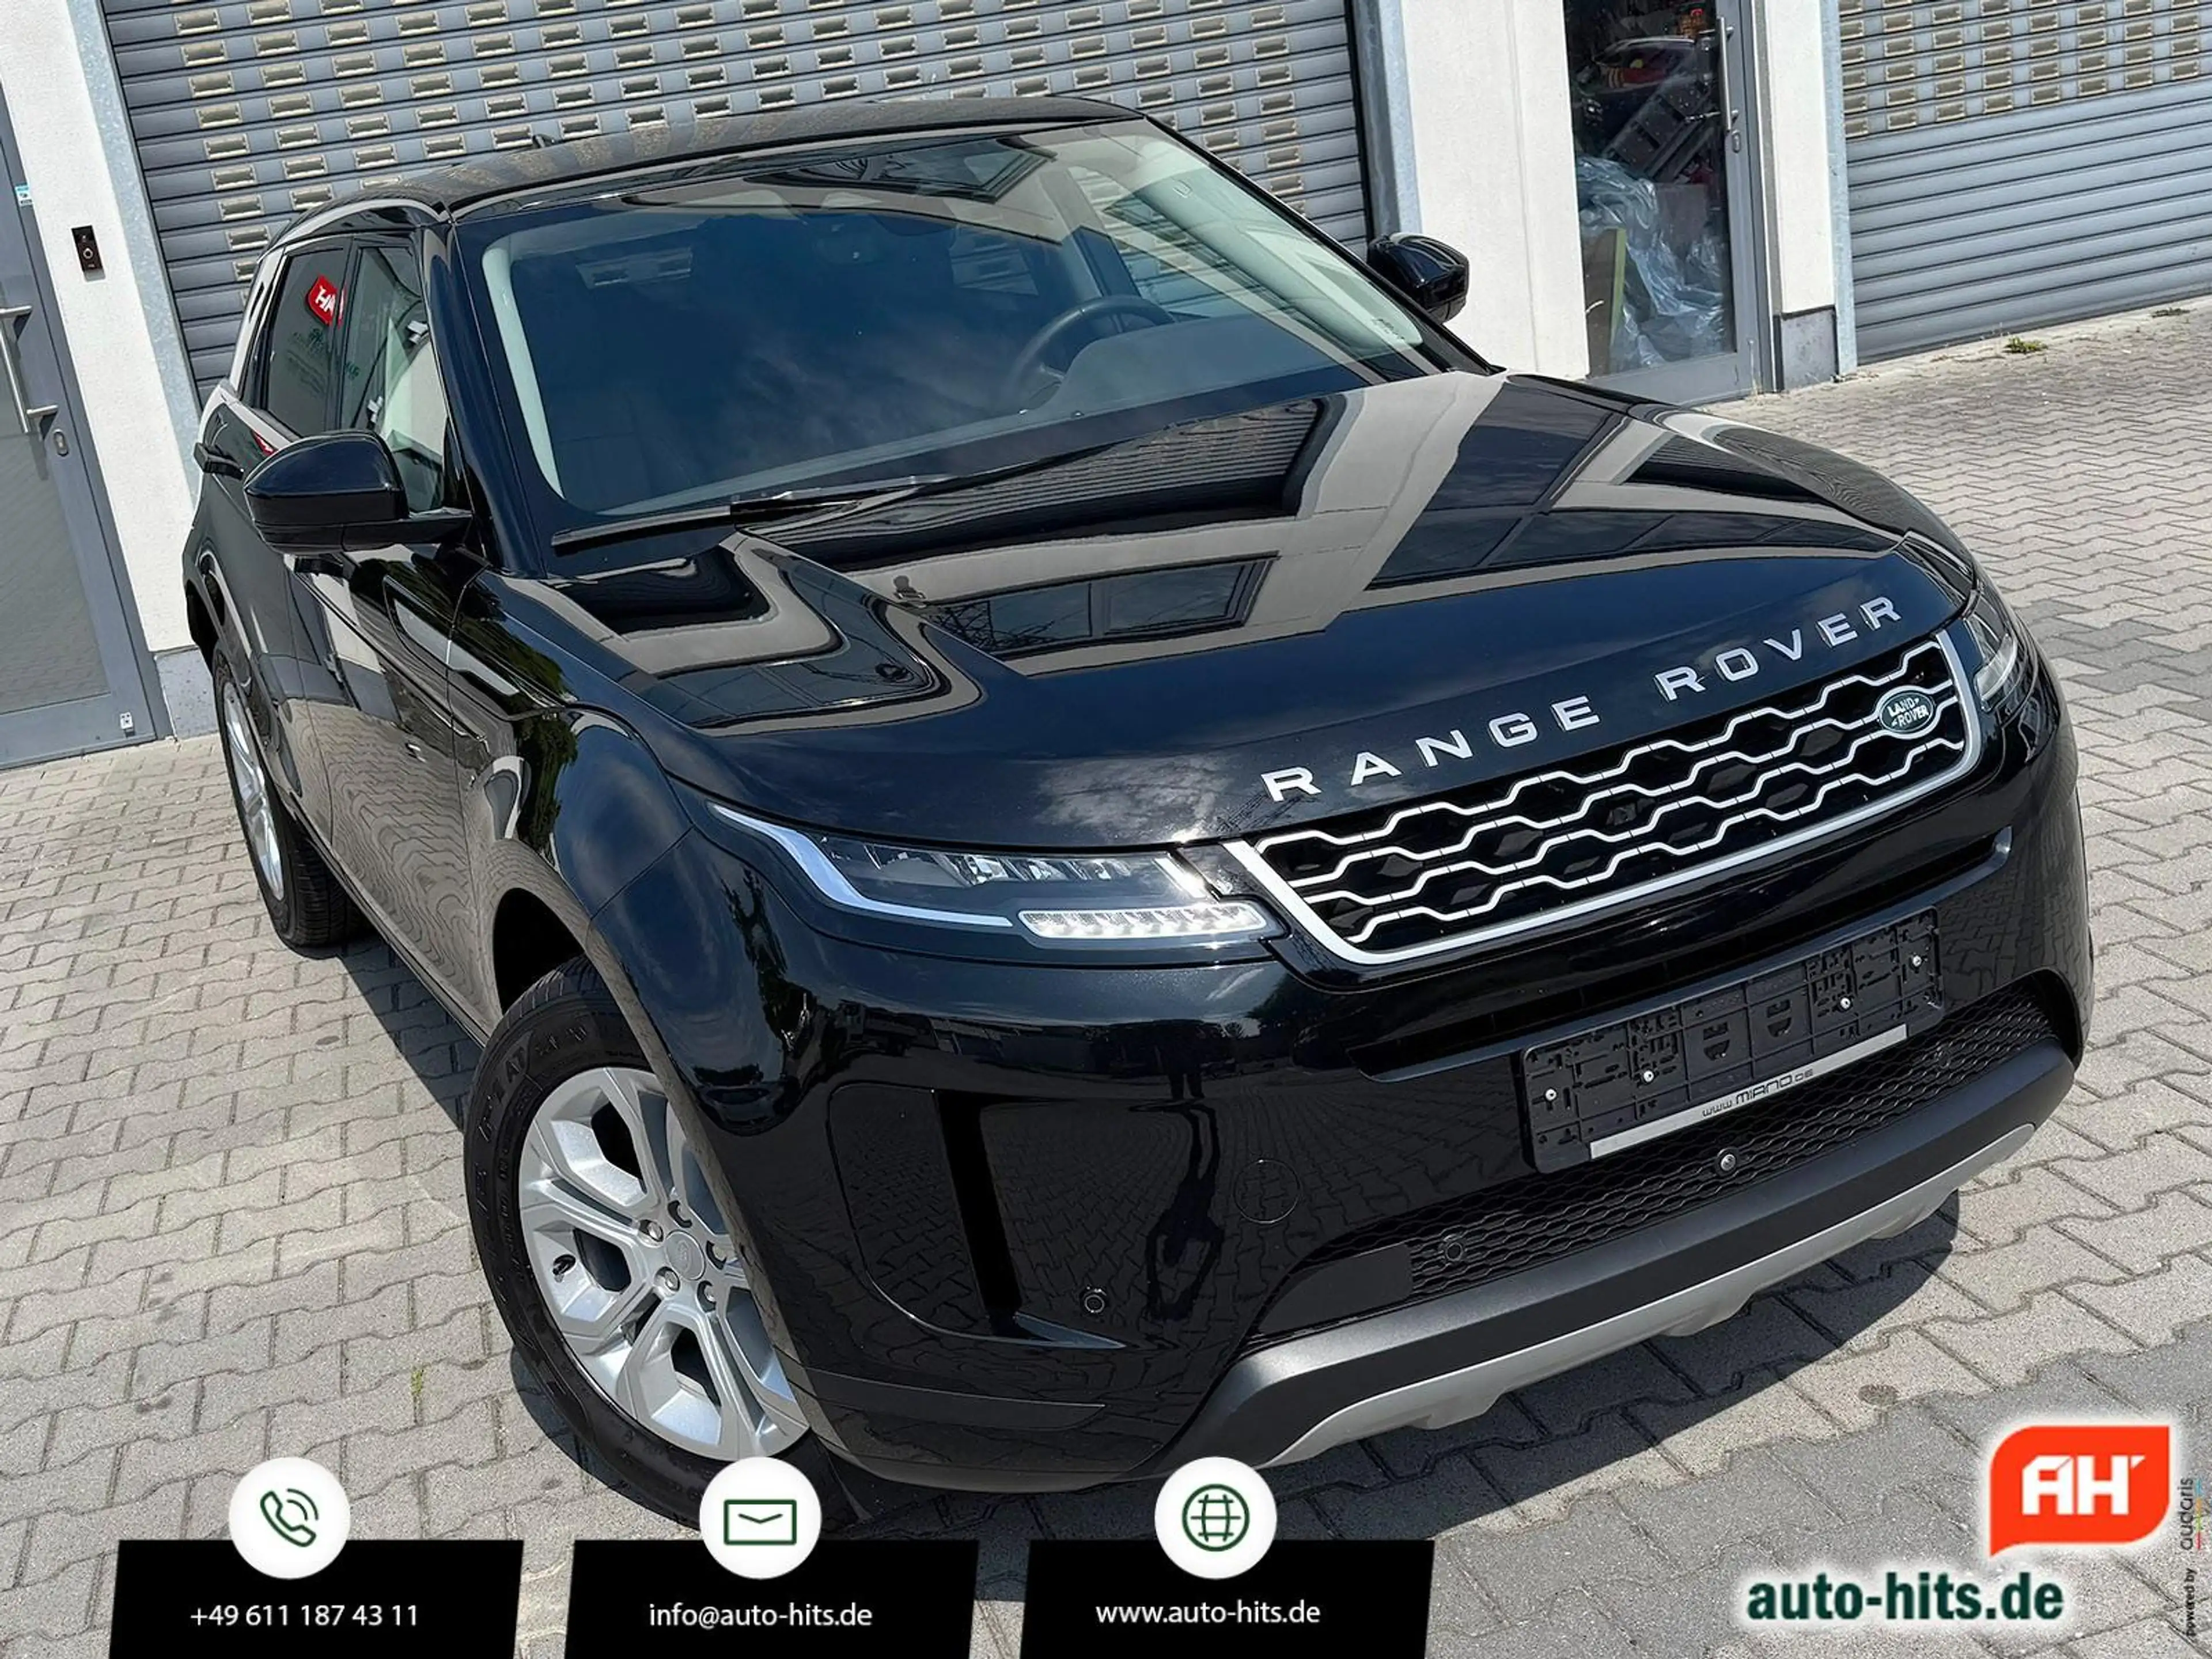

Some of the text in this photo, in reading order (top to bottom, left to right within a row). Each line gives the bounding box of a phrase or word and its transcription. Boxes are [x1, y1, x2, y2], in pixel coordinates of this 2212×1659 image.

[1261, 596, 1902, 802] RANGE ROVER
[1887, 697, 1916, 717] LAND
[1896, 704, 1930, 727] ROVER
